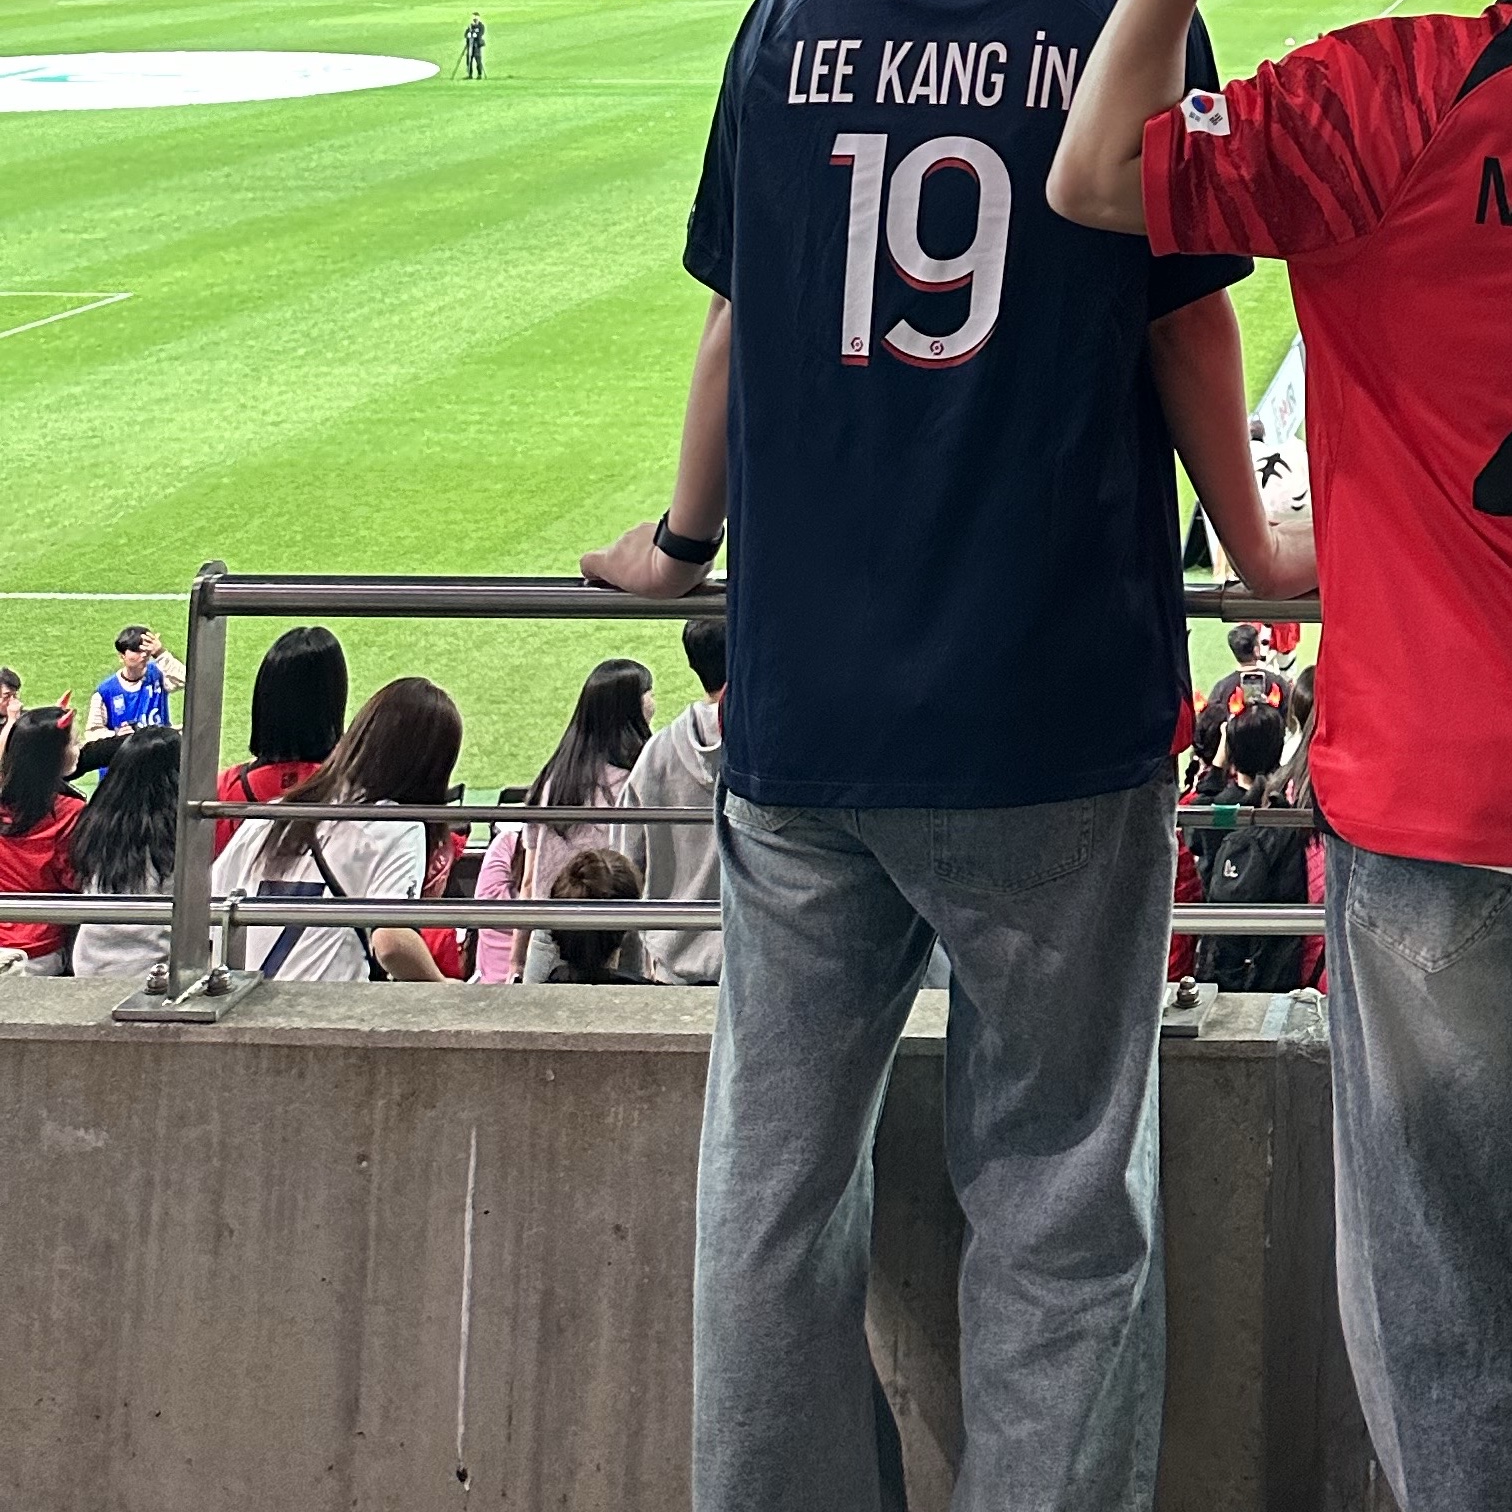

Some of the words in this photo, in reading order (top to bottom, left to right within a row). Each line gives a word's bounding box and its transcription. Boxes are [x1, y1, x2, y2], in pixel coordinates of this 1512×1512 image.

[787, 39, 863, 105] LEE
[875, 40, 1008, 107] KANG
[829, 132, 1012, 370] 19
